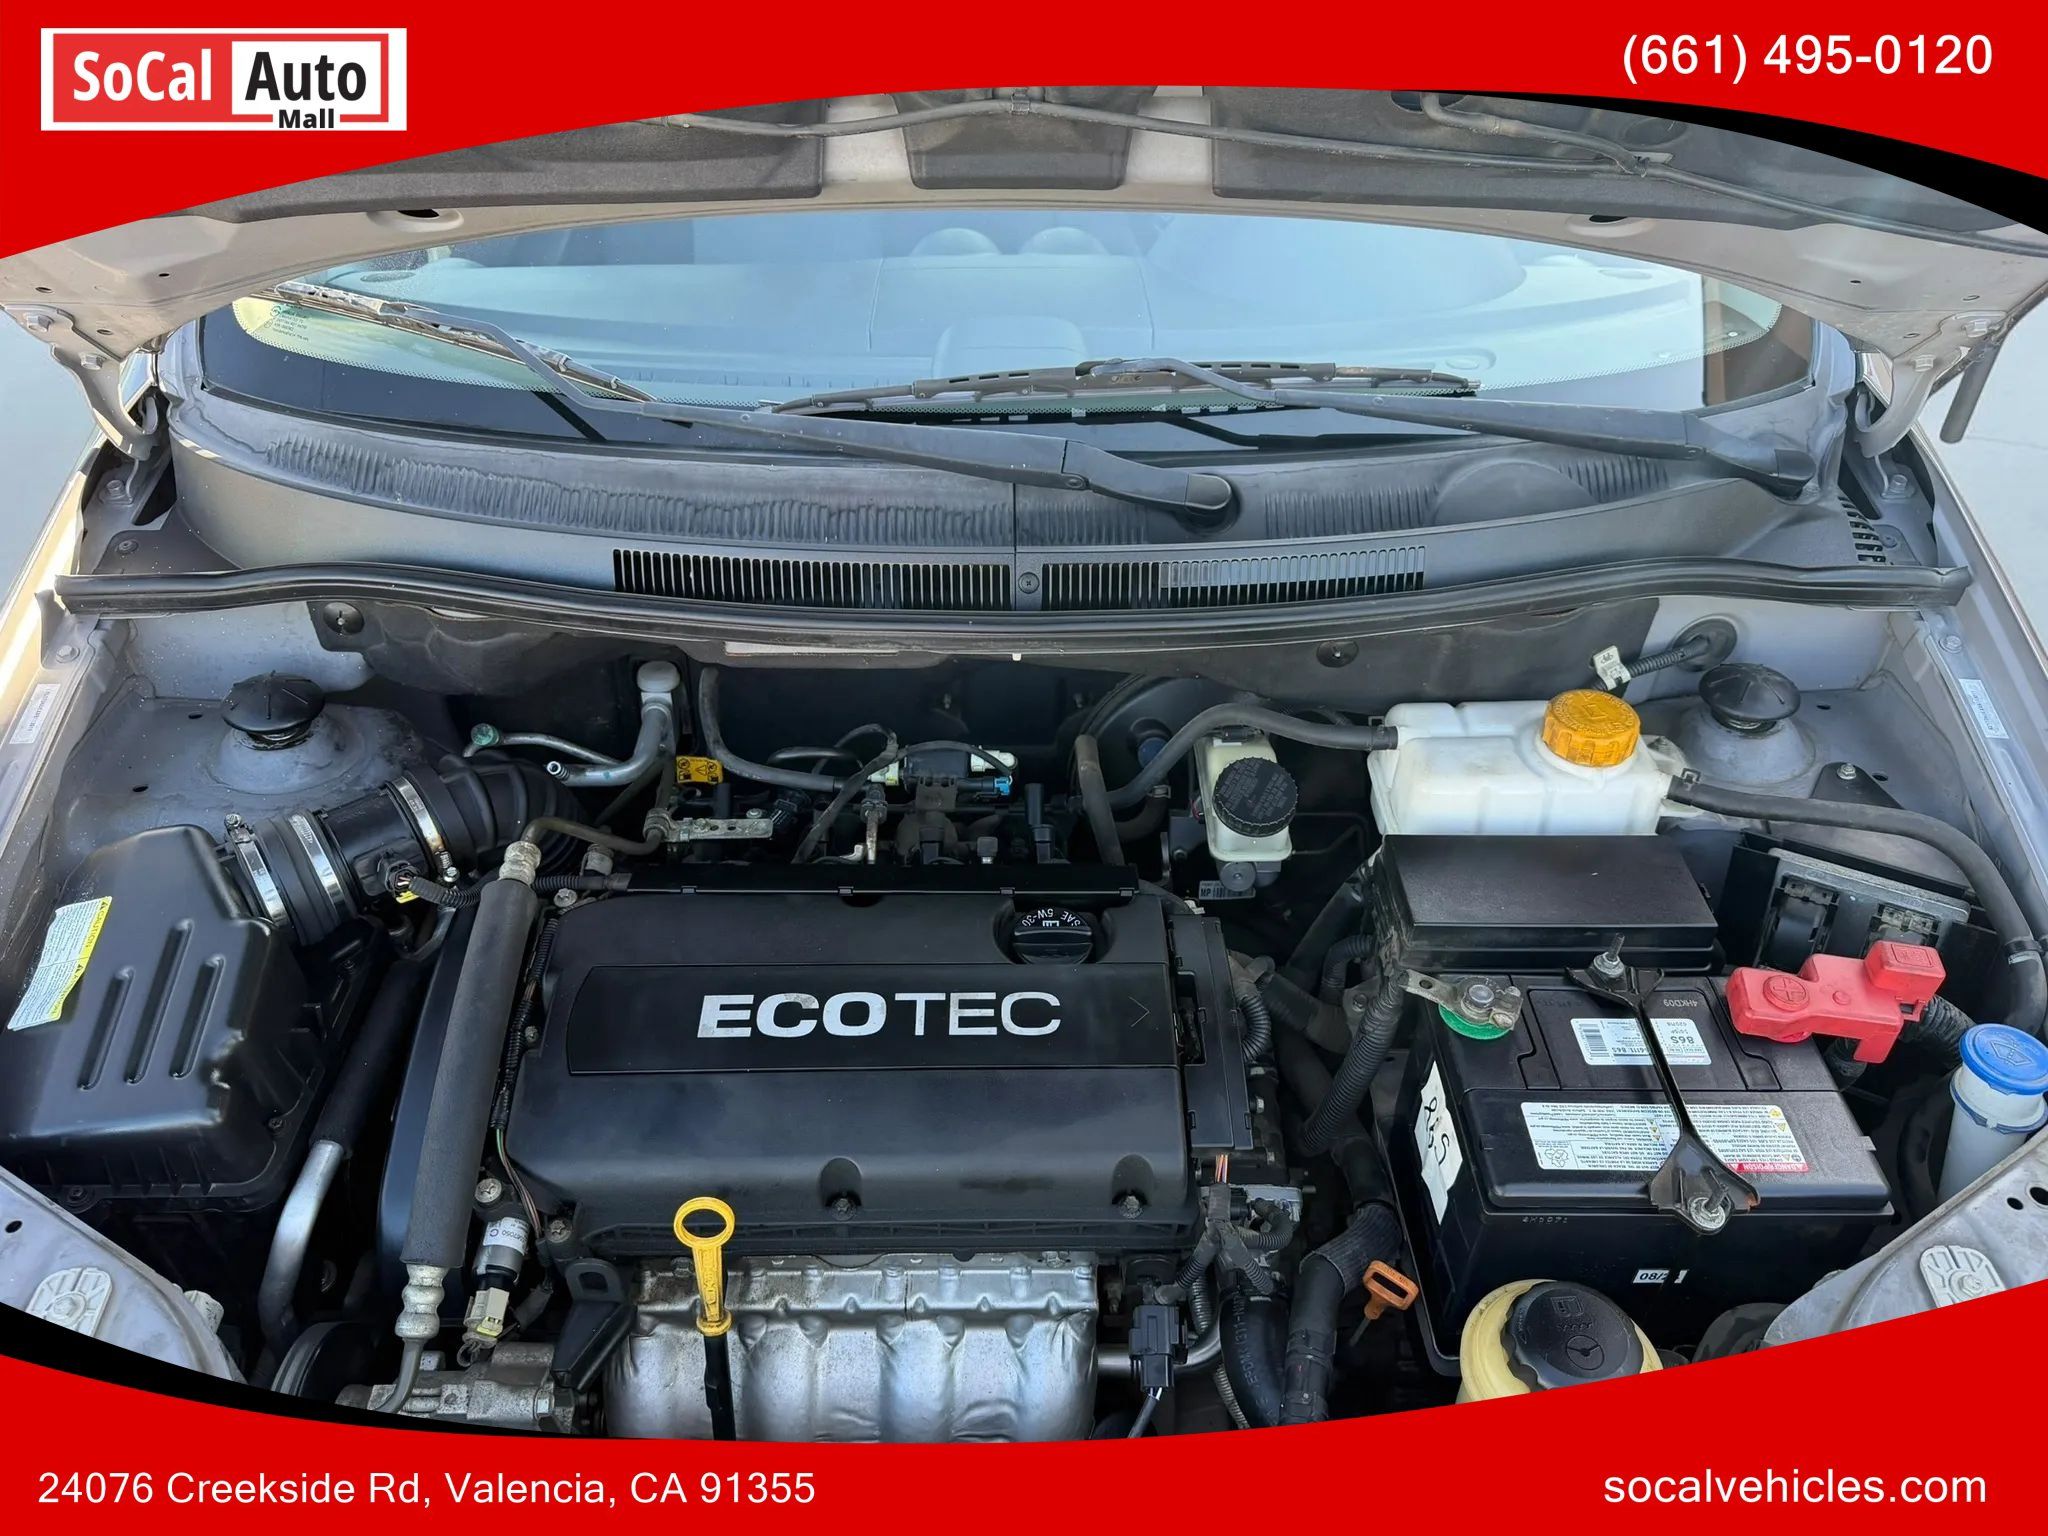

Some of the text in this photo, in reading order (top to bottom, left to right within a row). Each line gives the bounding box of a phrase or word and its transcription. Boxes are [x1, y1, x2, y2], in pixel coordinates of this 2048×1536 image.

[1021, 908, 1081, 927] SAE 5W-30
[696, 991, 1062, 1039] ECOTEC
